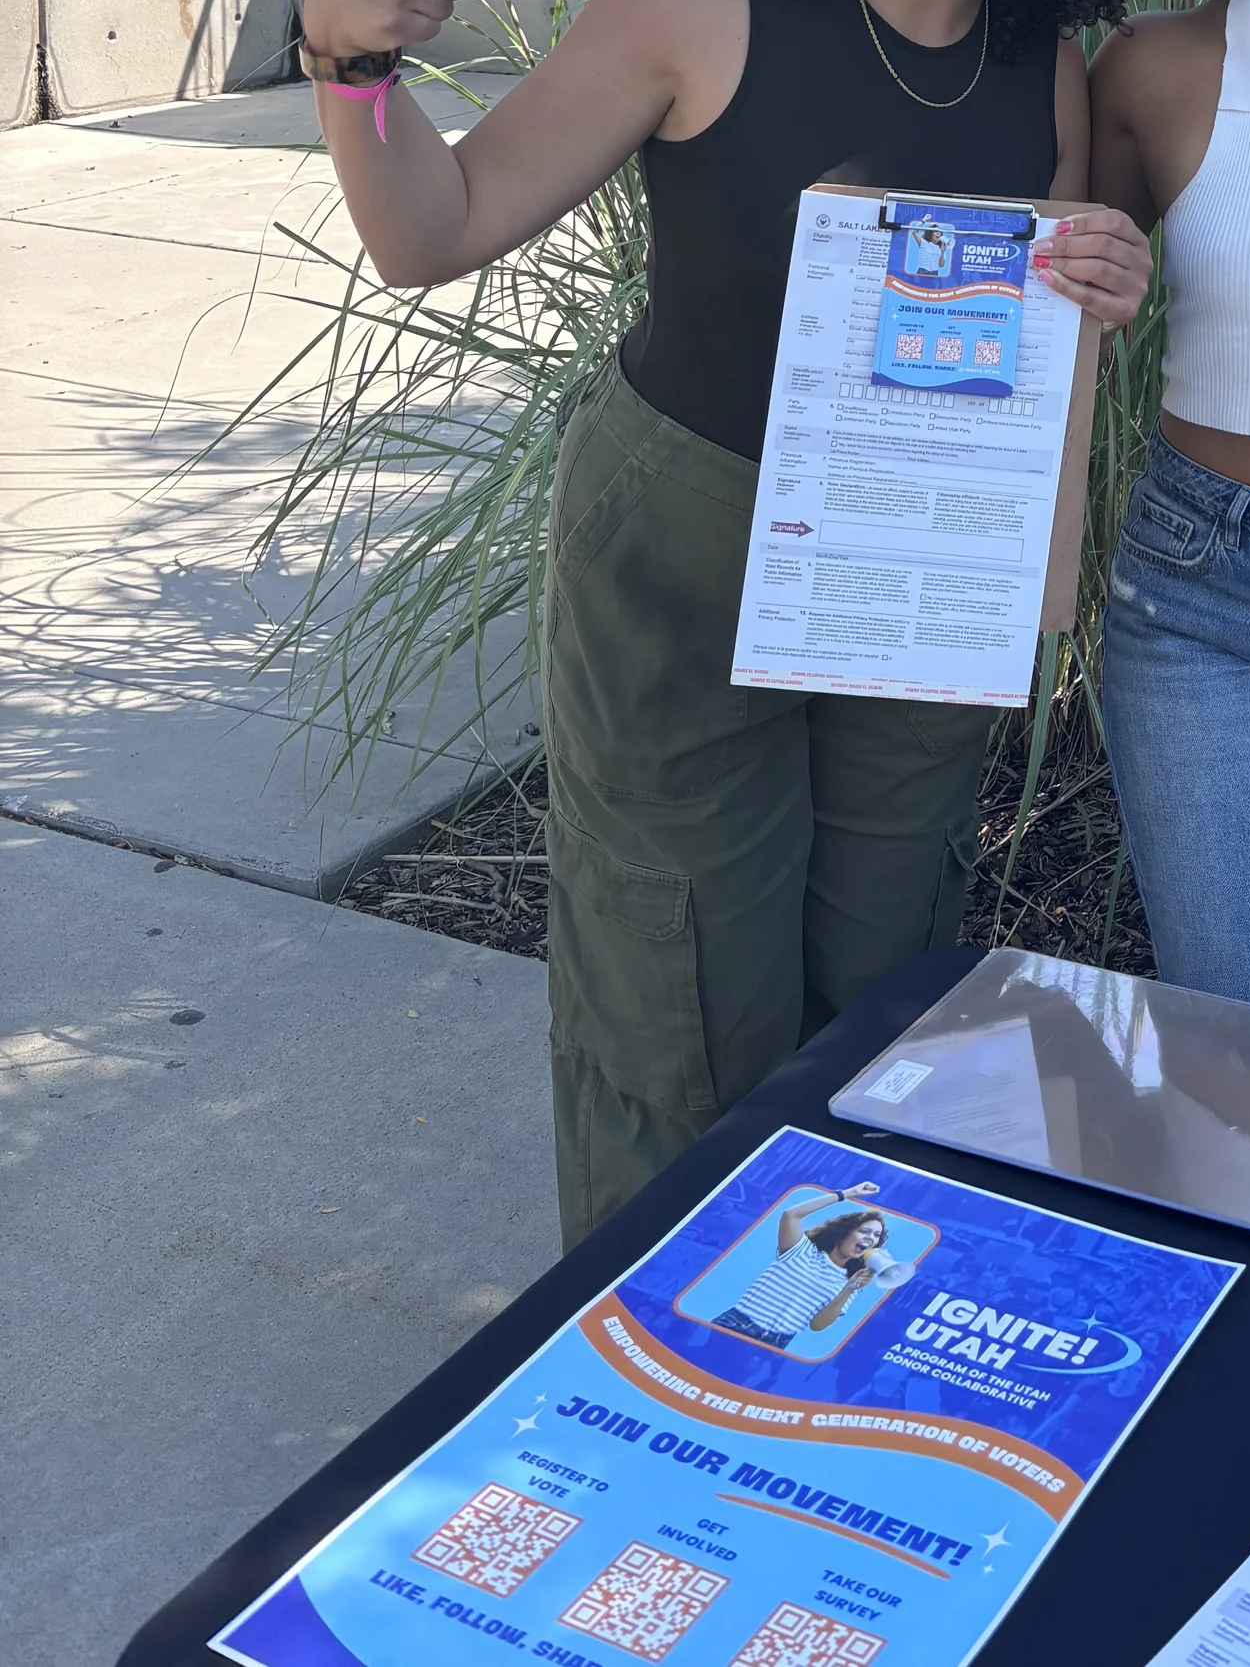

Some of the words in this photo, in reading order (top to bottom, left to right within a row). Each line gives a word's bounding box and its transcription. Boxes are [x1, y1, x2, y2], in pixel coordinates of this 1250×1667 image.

[838, 221, 860, 230] SALT
[962, 255, 992, 265] UTAH
[963, 245, 1009, 258] IGNITE!
[898, 305, 923, 314] JOIN
[924, 307, 945, 315] OUR
[947, 309, 1008, 321] MOVEMENT!
[770, 522, 805, 533] Signature
[905, 1317, 1016, 1371] UTAH
[922, 1291, 1099, 1365] IGNITE!
[882, 1350, 930, 1375] DONOR
[931, 1368, 1037, 1410] COLLABORATIVE
[890, 1343, 902, 1352] A
[902, 1346, 969, 1375] PROGRAM
[968, 1367, 987, 1380] OF
[988, 1374, 1012, 1391] THE
[1013, 1382, 1052, 1403] UTAH
[602, 1315, 703, 1401] EMPOWERING
[701, 1392, 743, 1413] THE
[741, 1405, 805, 1425] NEXT
[811, 1413, 959, 1445] GENERATION
[958, 1435, 989, 1454] OF
[988, 1445, 1066, 1493] VOTERS
[517, 1450, 589, 1486] REGISTER
[587, 1477, 610, 1493] TO
[527, 1476, 570, 1499] VOTE
[555, 1395, 651, 1443] JOIN
[648, 1431, 730, 1476] OUR
[728, 1461, 974, 1567] MOVEMENT!
[657, 1524, 738, 1562] INVOLVED
[696, 1518, 730, 1535] GET
[813, 1589, 882, 1621] SURVEY
[822, 1569, 865, 1595] TAKE
[864, 1584, 903, 1609] OUR
[368, 1568, 427, 1605] LIKE,
[429, 1595, 528, 1650] FOLLOW,
[532, 1640, 604, 1667] SHA
